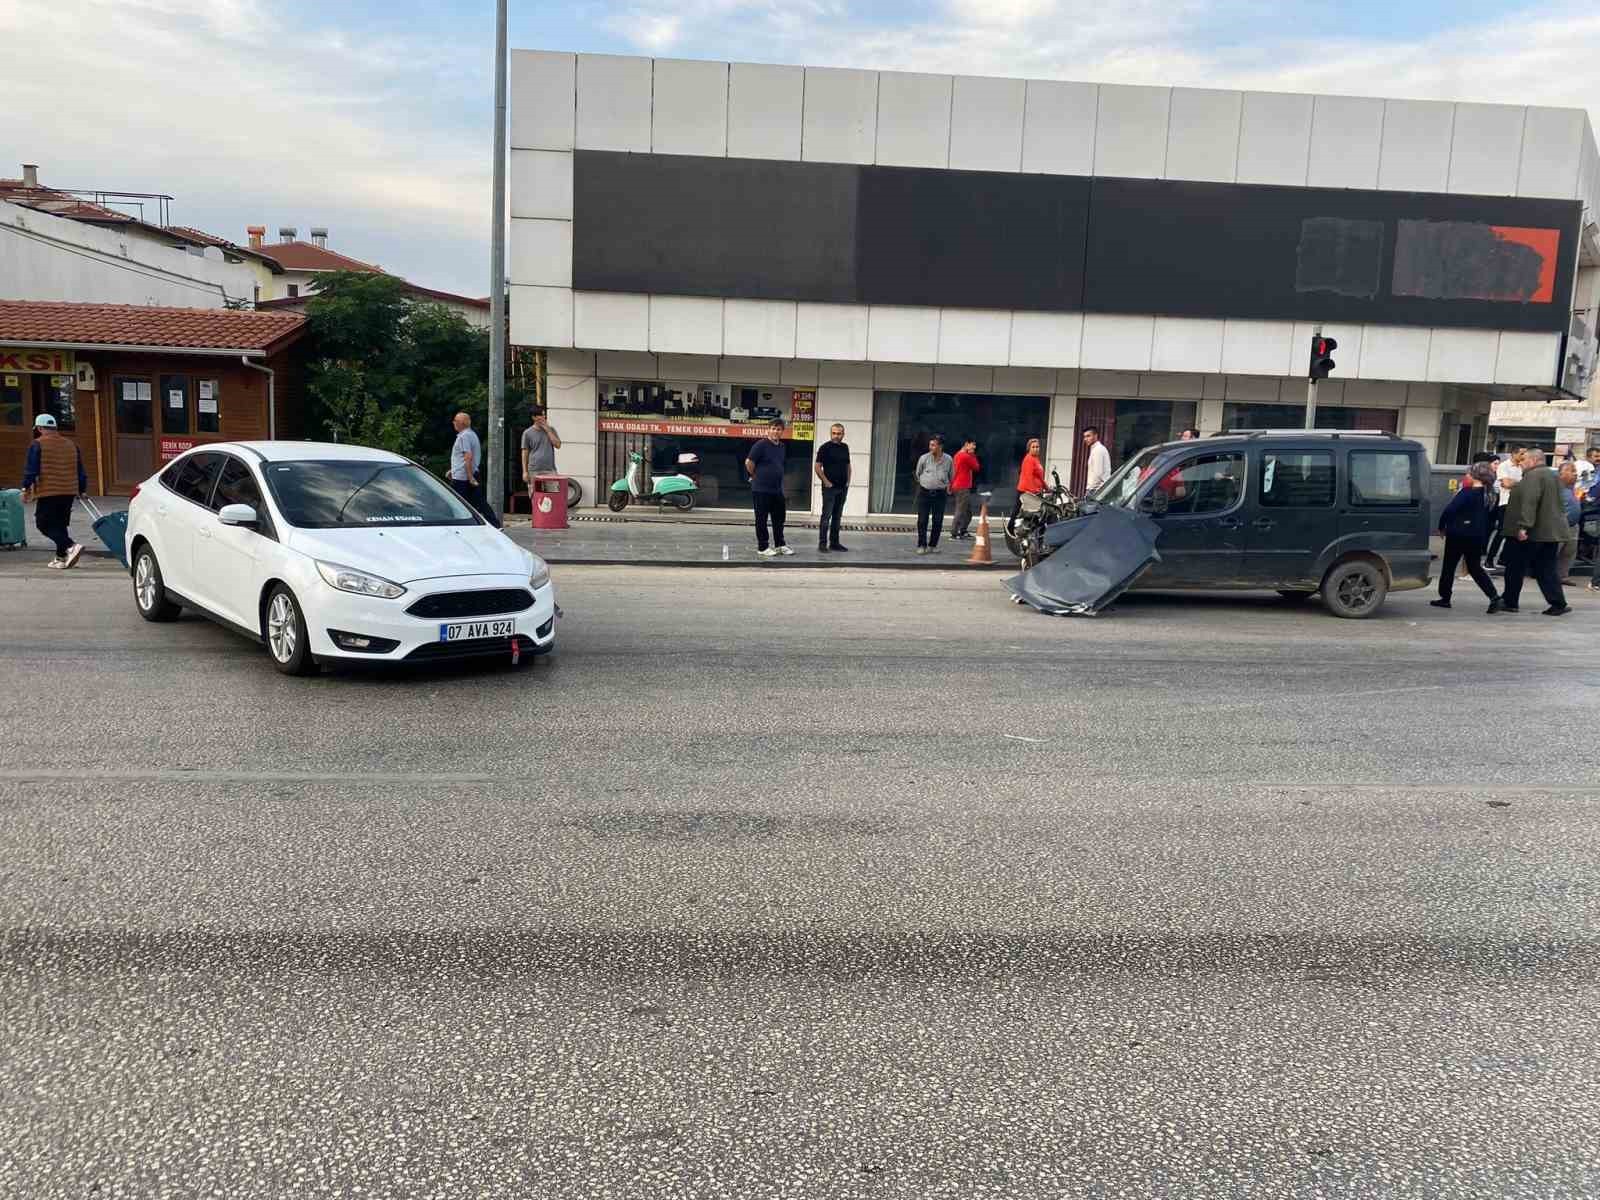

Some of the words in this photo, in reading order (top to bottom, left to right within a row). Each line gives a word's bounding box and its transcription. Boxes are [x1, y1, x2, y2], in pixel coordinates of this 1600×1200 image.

[448, 626, 462, 640] 07
[468, 623, 489, 638] AVA
[492, 622, 512, 636] 924
